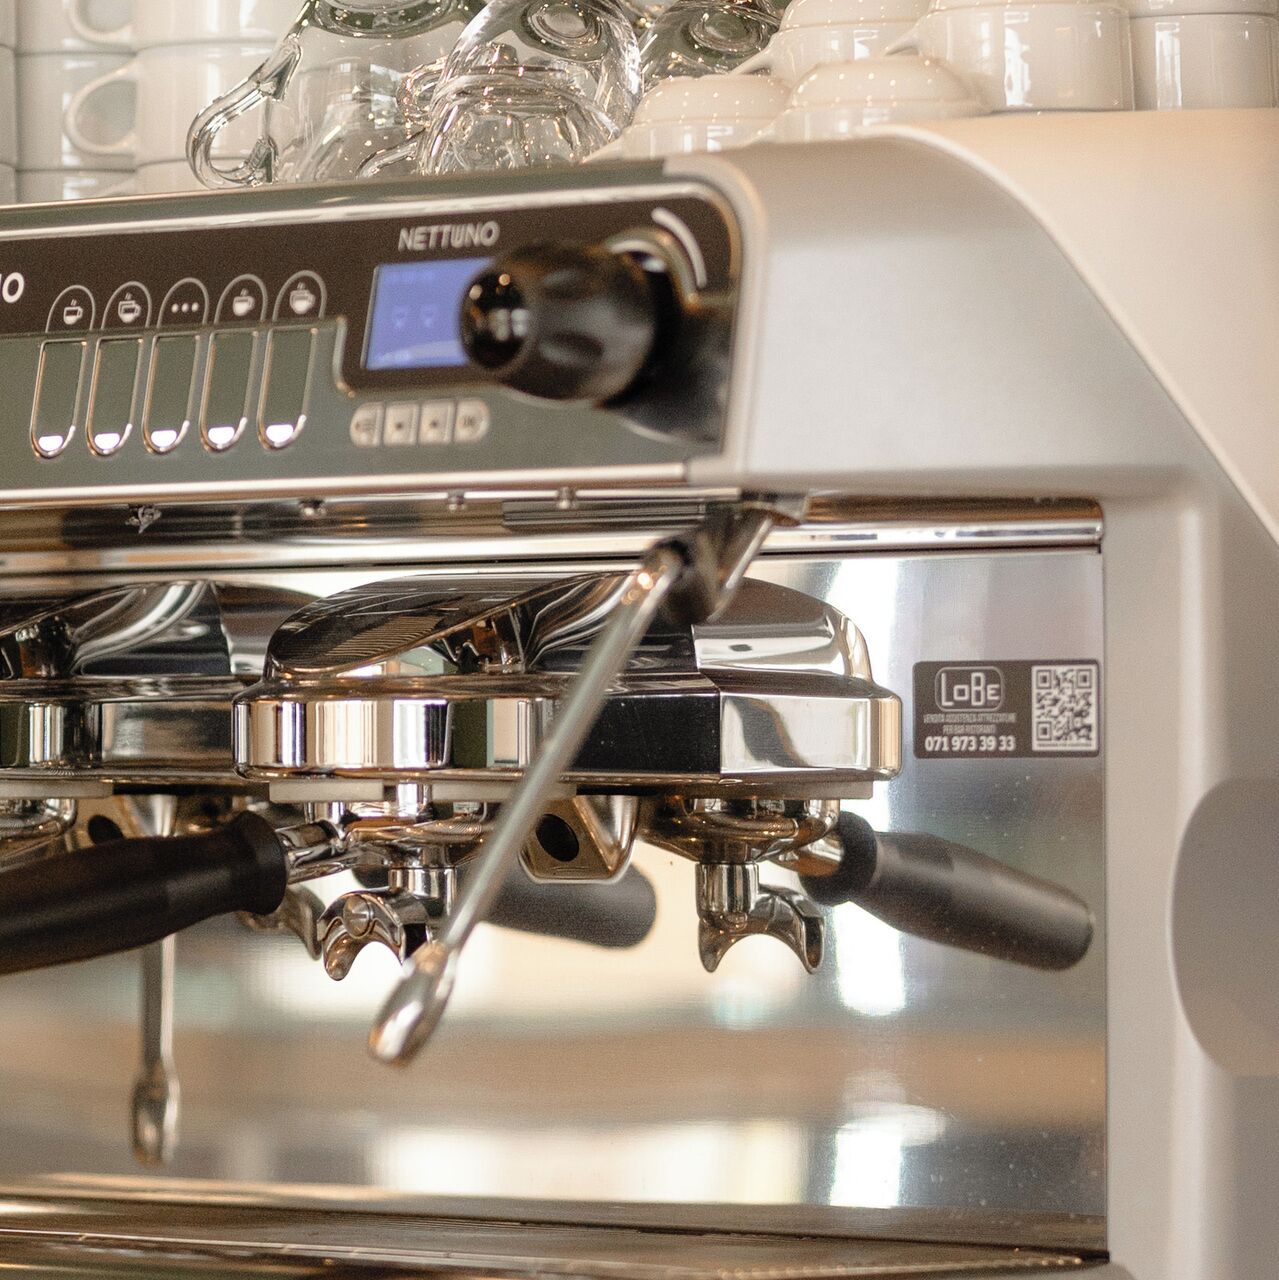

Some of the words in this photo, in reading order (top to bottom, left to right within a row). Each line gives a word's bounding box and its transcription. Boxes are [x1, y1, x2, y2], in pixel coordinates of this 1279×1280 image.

[397, 220, 501, 252] NETTUNO
[924, 735, 950, 752] 071
[951, 735, 977, 752] 973
[979, 735, 997, 751] 39
[998, 735, 1016, 751] 33
